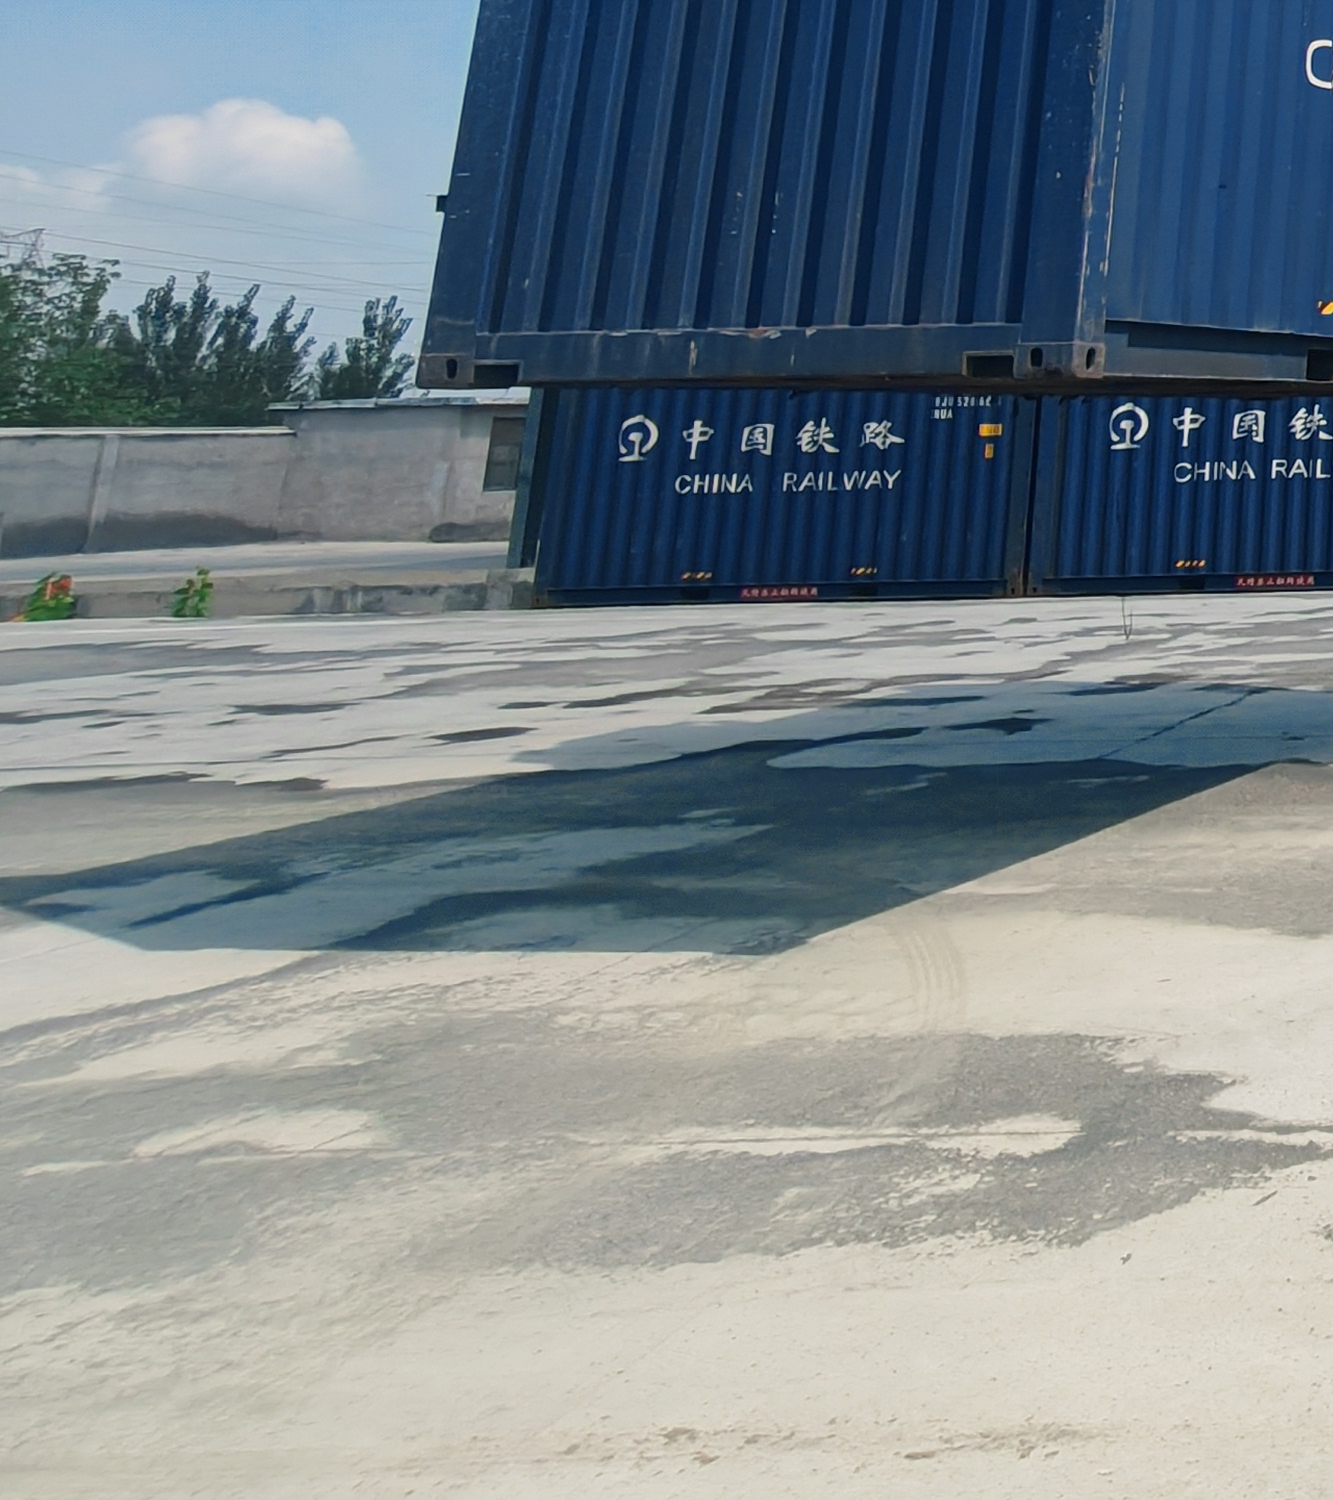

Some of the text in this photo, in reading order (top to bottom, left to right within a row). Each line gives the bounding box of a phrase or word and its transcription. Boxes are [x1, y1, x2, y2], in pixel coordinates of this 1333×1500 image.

[682, 417, 905, 460] 中国铁路
[674, 468, 902, 495] CHINA RAILWAY
[1173, 459, 1256, 483] CHINA
